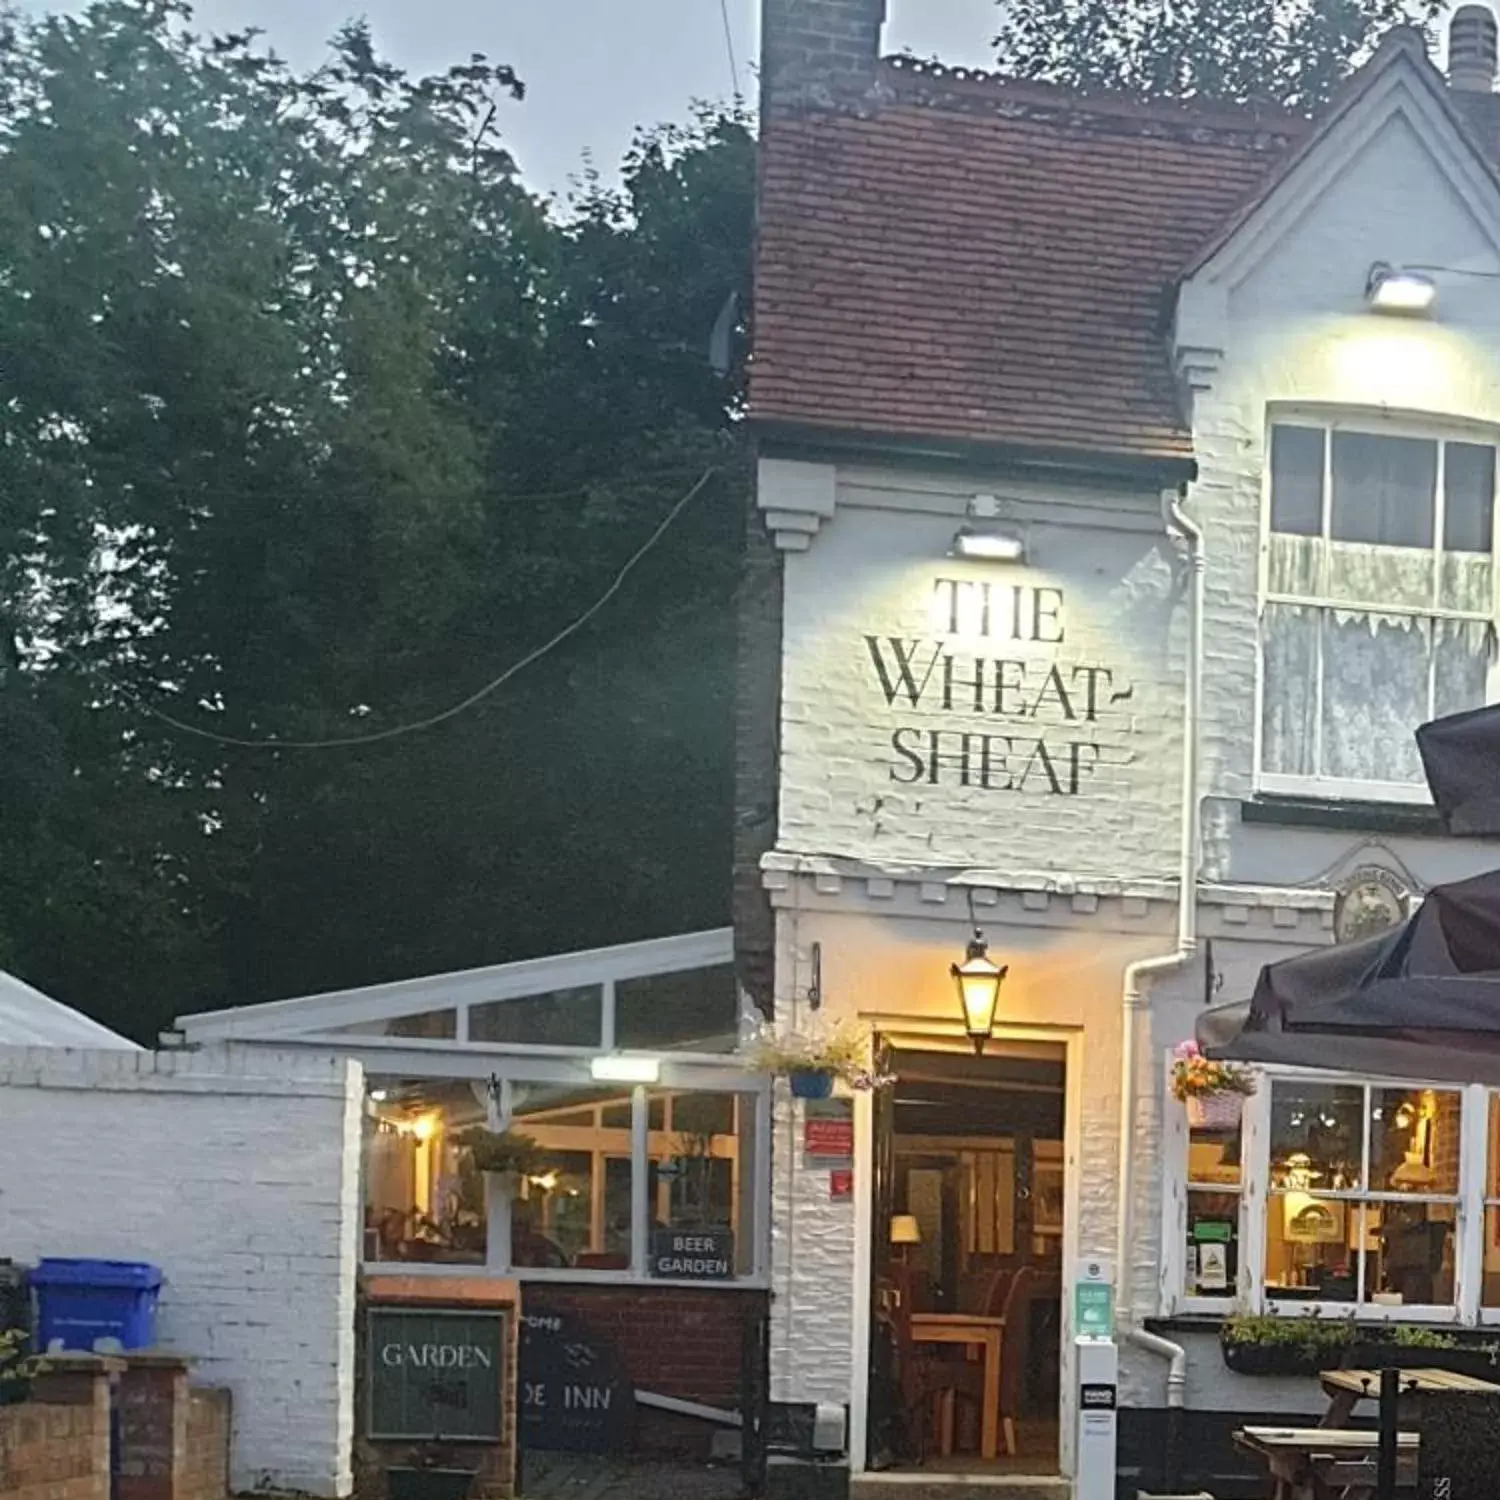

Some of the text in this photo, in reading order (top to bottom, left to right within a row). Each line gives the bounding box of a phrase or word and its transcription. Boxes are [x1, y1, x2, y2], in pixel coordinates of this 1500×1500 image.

[935, 577, 1065, 643] THE
[889, 727, 1099, 795] SHEAF
[673, 1236, 715, 1252] BEER
[657, 1258, 728, 1274] GARDEN
[382, 1342, 491, 1368] GARDEN
[563, 1384, 612, 1410] INN
